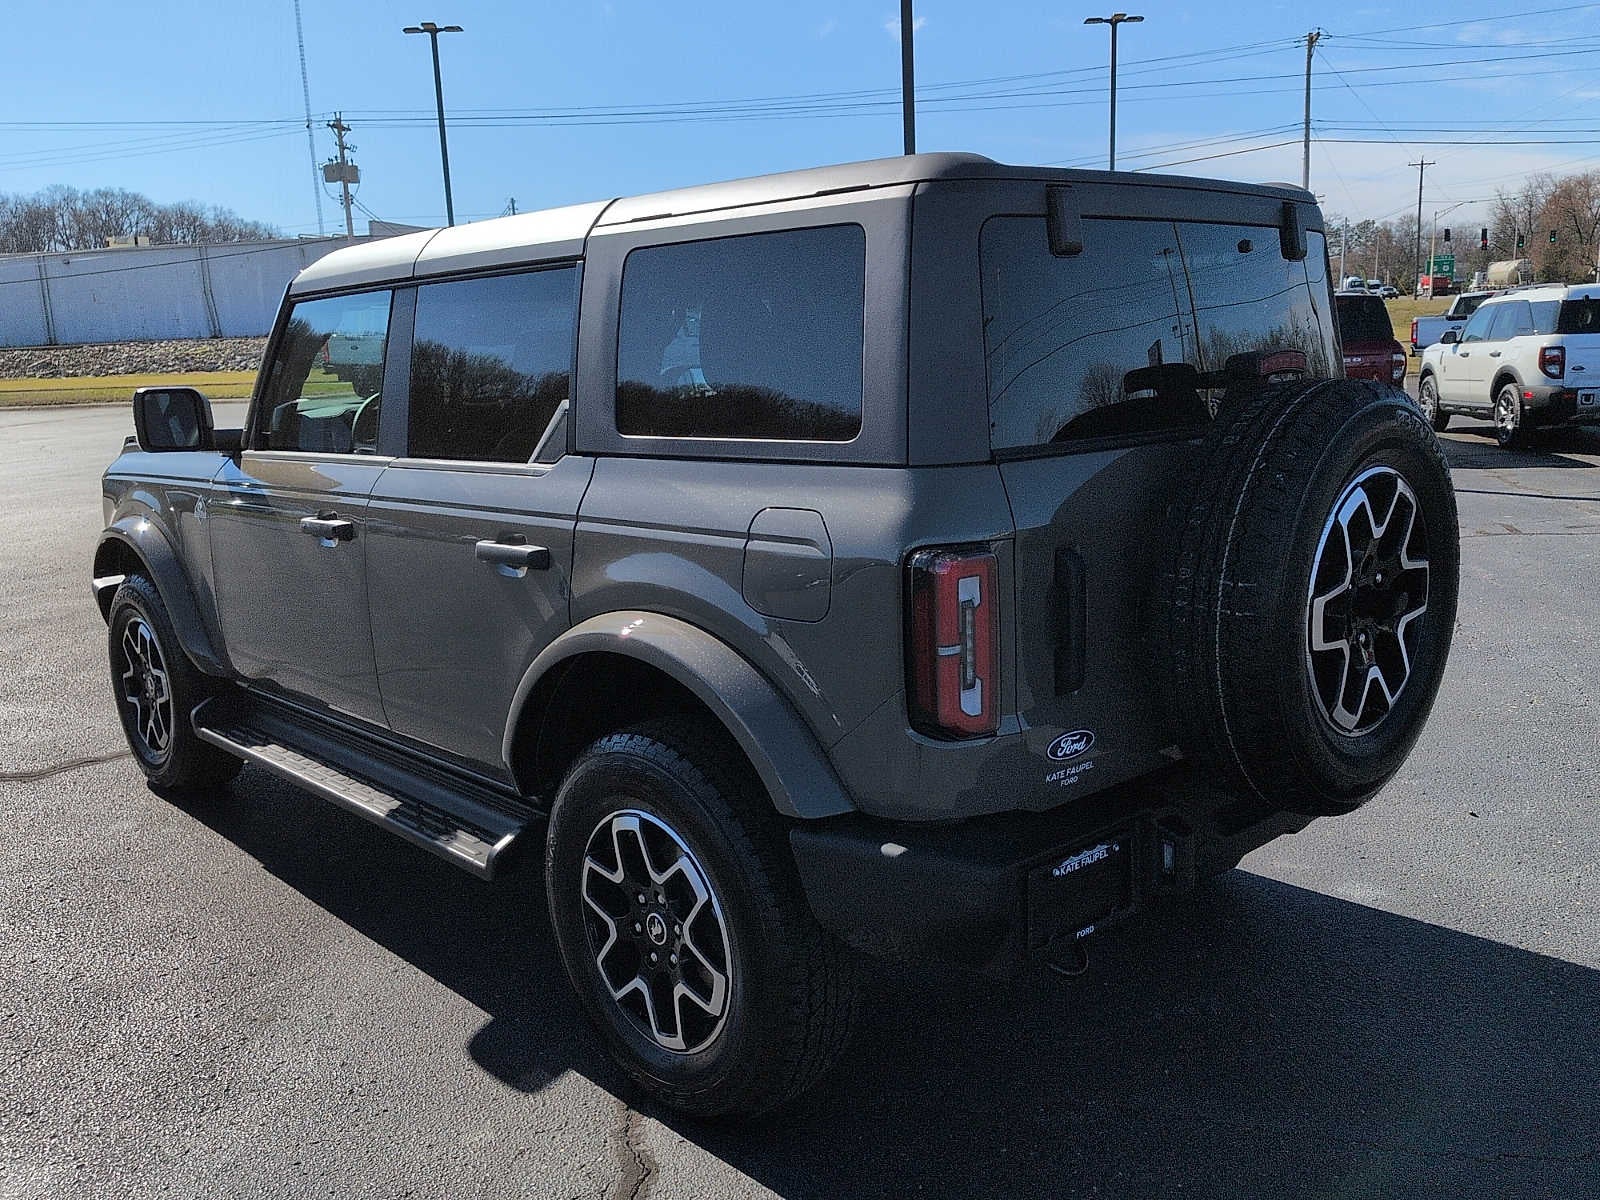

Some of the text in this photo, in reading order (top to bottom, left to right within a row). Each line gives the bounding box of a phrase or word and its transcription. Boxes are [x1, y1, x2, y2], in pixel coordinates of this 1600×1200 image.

[1057, 734, 1087, 757] Ford
[1045, 761, 1095, 784] KATE FAUPEL
[1061, 775, 1079, 787] FORD
[1060, 849, 1109, 877] KATE FAUPEL
[1076, 925, 1095, 940] FORD
